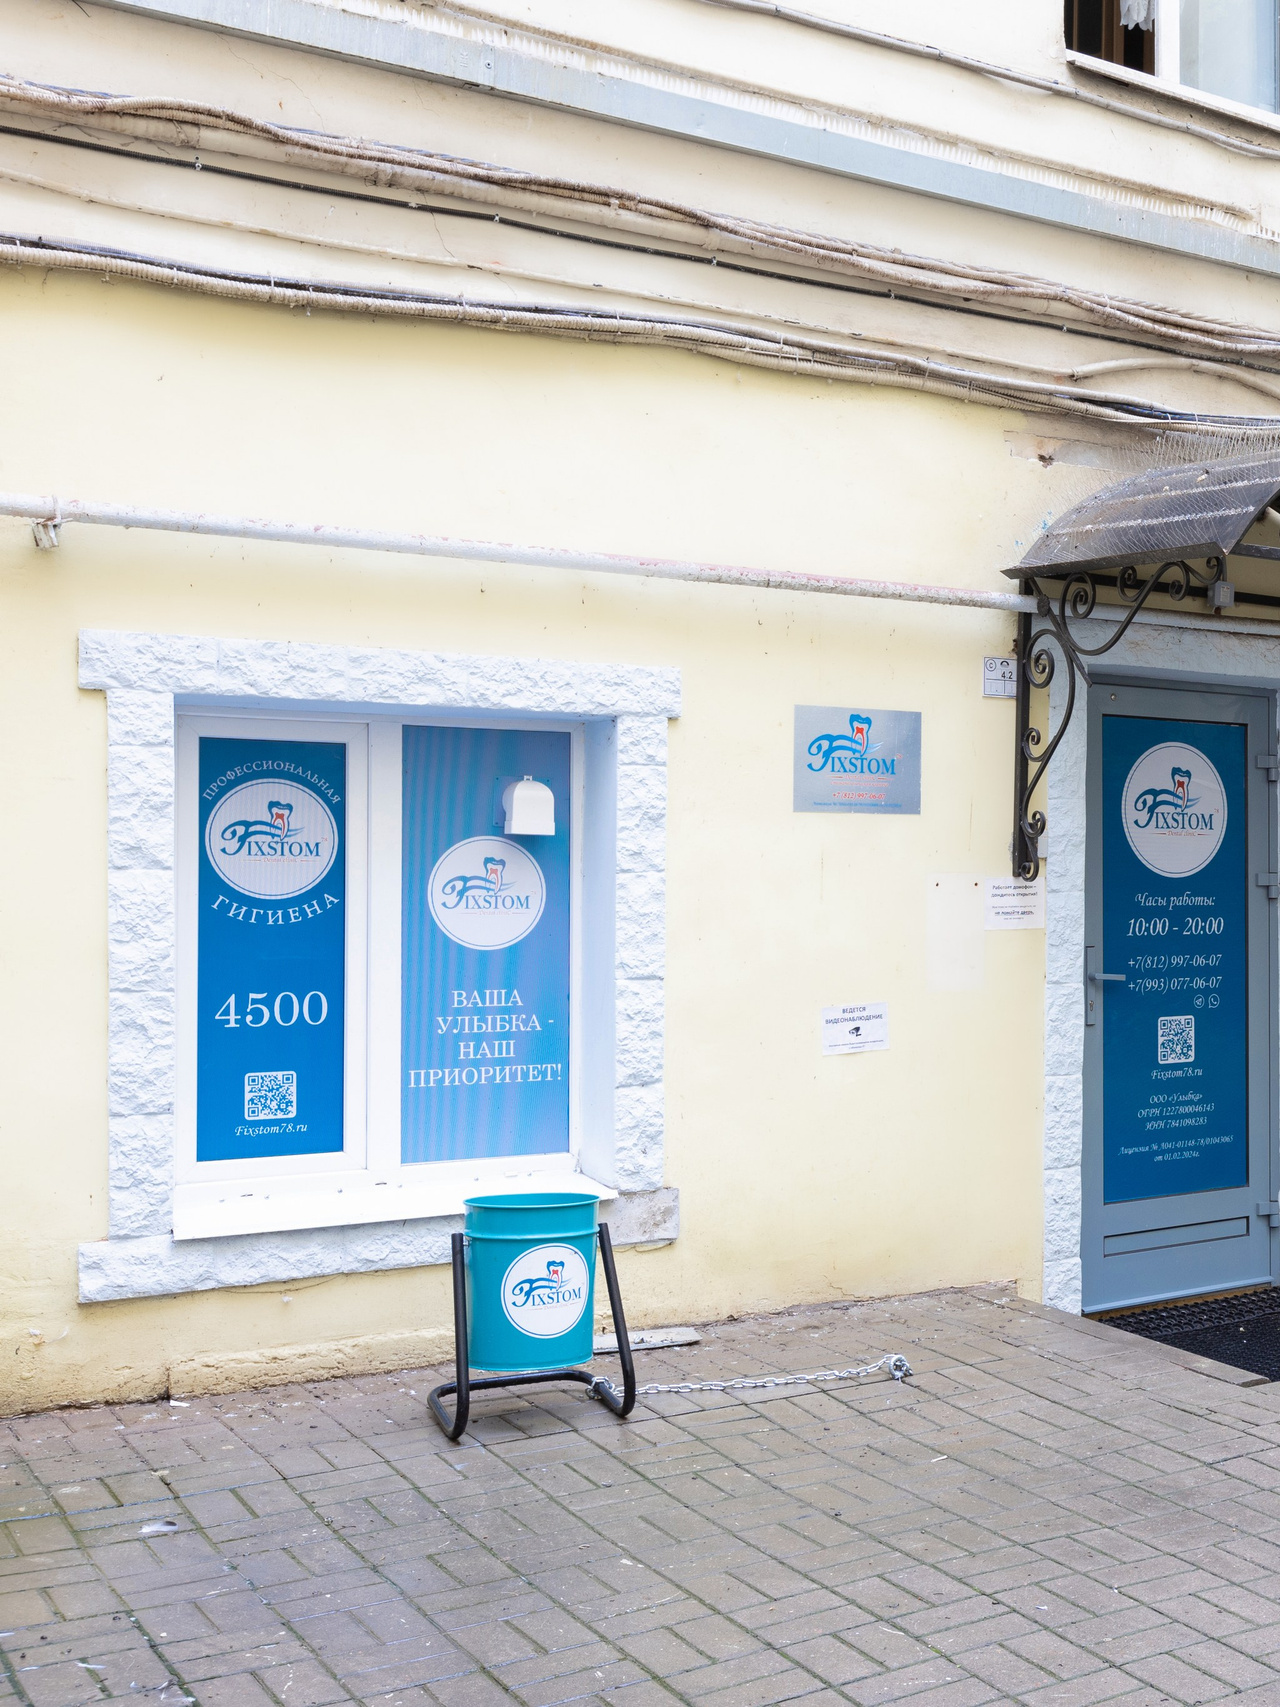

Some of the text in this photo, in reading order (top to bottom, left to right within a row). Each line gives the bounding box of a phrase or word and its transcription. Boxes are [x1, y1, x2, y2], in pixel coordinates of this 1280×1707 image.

[807, 734, 896, 775] FIXSTOM
[202, 760, 341, 805] ПРОФЕССИОНАЛЬНАЯ
[1133, 788, 1214, 831] FIXSTOM
[220, 819, 321, 857] FIXSTOM
[441, 875, 531, 910] FIXSTOM
[1135, 891, 1216, 910] Часы работы:
[210, 892, 340, 925] ГИГИЕНА
[1126, 917, 1169, 937] 10:00
[1182, 917, 1225, 935] 20:00
[1127, 954, 1222, 971] +7(812) 997-06-07
[1127, 976, 1222, 995] +7(993) 077-06-07
[451, 989, 524, 1008] ВАША
[214, 990, 329, 1028] 4500
[825, 1014, 883, 1024] ВИДЕОНАБЛЮДЕНИЕ
[842, 1006, 866, 1014] ВЕДЕТСЯ
[436, 1014, 542, 1034] УЛЫБКА
[458, 1040, 516, 1060] НАШ
[408, 1063, 562, 1088] ПРИОРИТЕТ!
[1151, 1067, 1203, 1080] Fixstom78.ru
[1149, 1090, 1203, 1104] ООО «Улыбка»
[1137, 1107, 1161, 1118] ОГРН
[234, 1122, 308, 1138] Fixstom78.ru
[1145, 1120, 1166, 1131] ИНН
[511, 1277, 582, 1307] FIXSTOM
